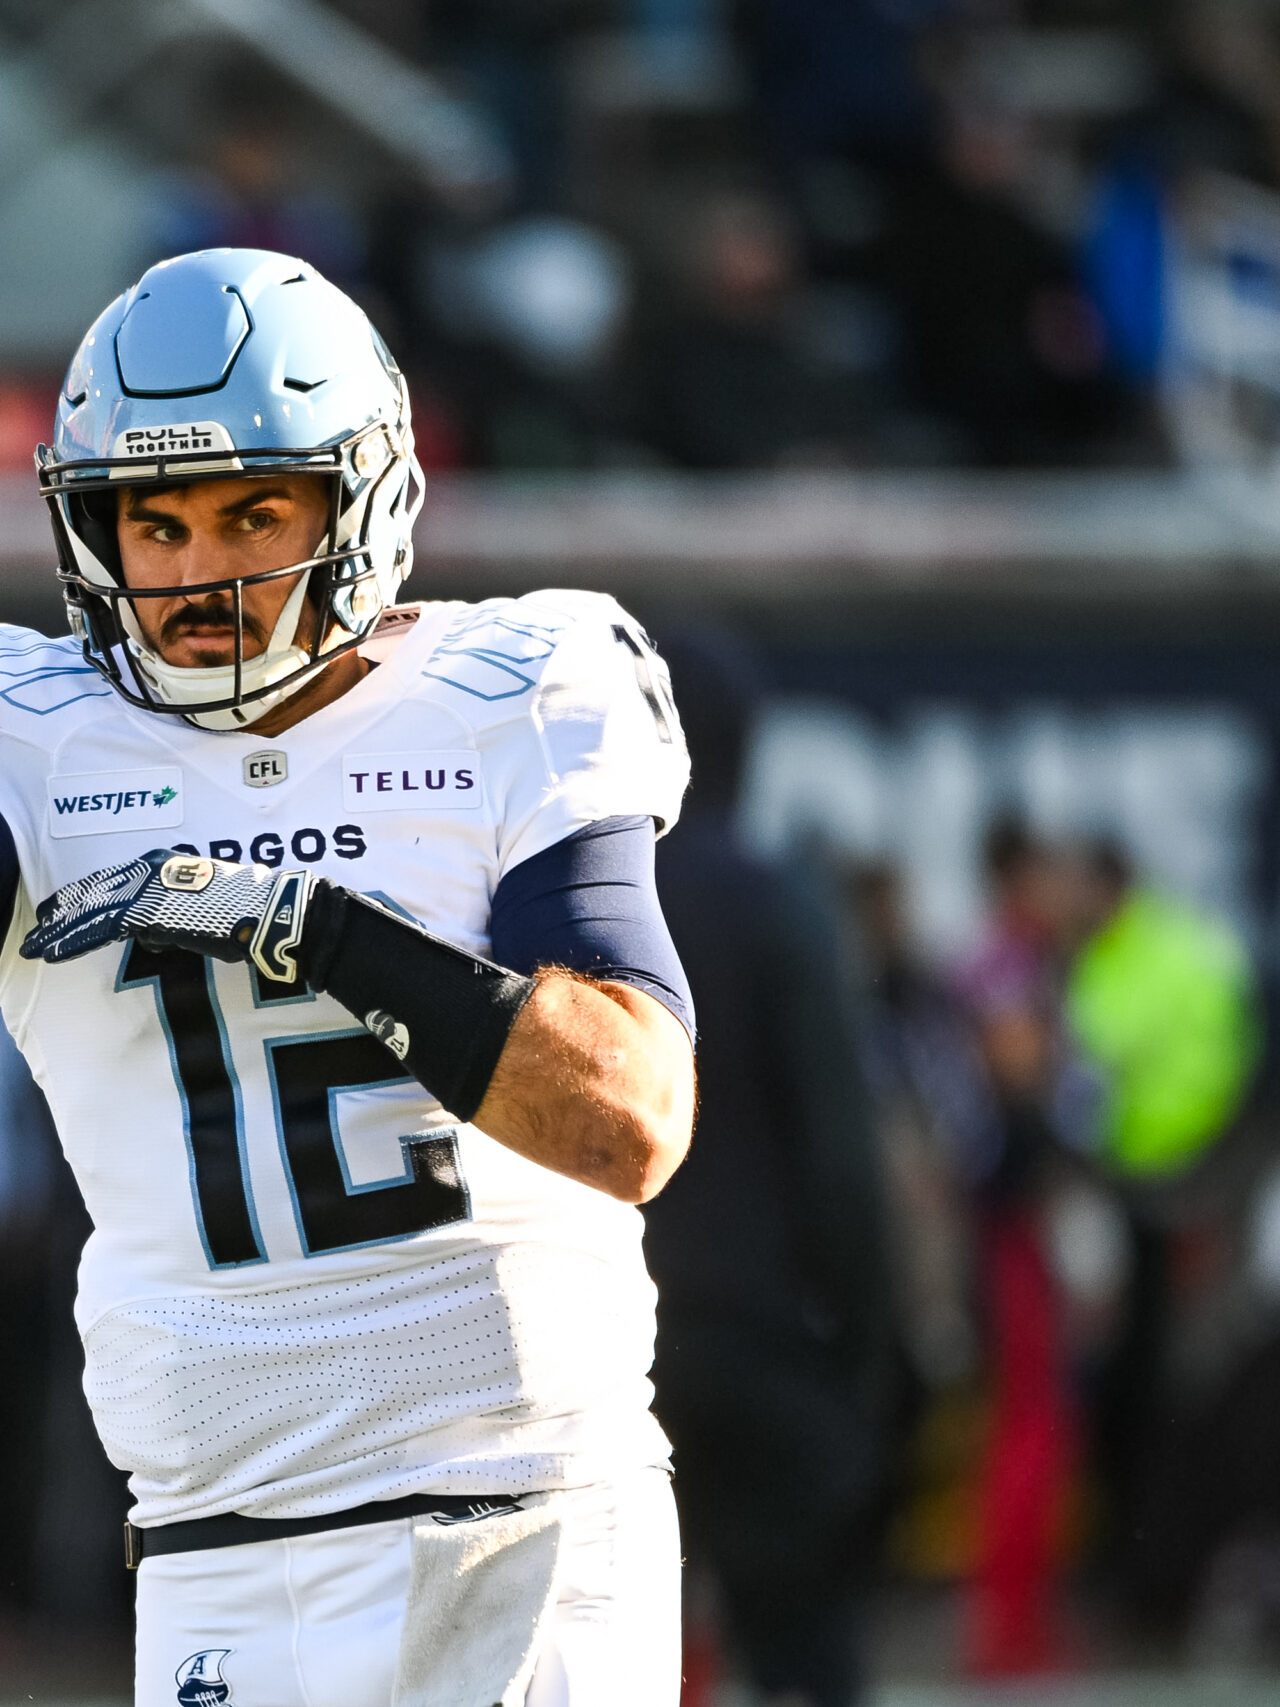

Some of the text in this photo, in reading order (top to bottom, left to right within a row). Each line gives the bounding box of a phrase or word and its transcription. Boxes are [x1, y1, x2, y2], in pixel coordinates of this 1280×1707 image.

[125, 426, 212, 443] PULL
[126, 438, 212, 455] TOGETHER
[249, 760, 282, 779] CFL
[348, 769, 474, 793] TELUS
[53, 790, 152, 815] WESTJET
[114, 890, 473, 1271] 12
[187, 1655, 207, 1676] A
